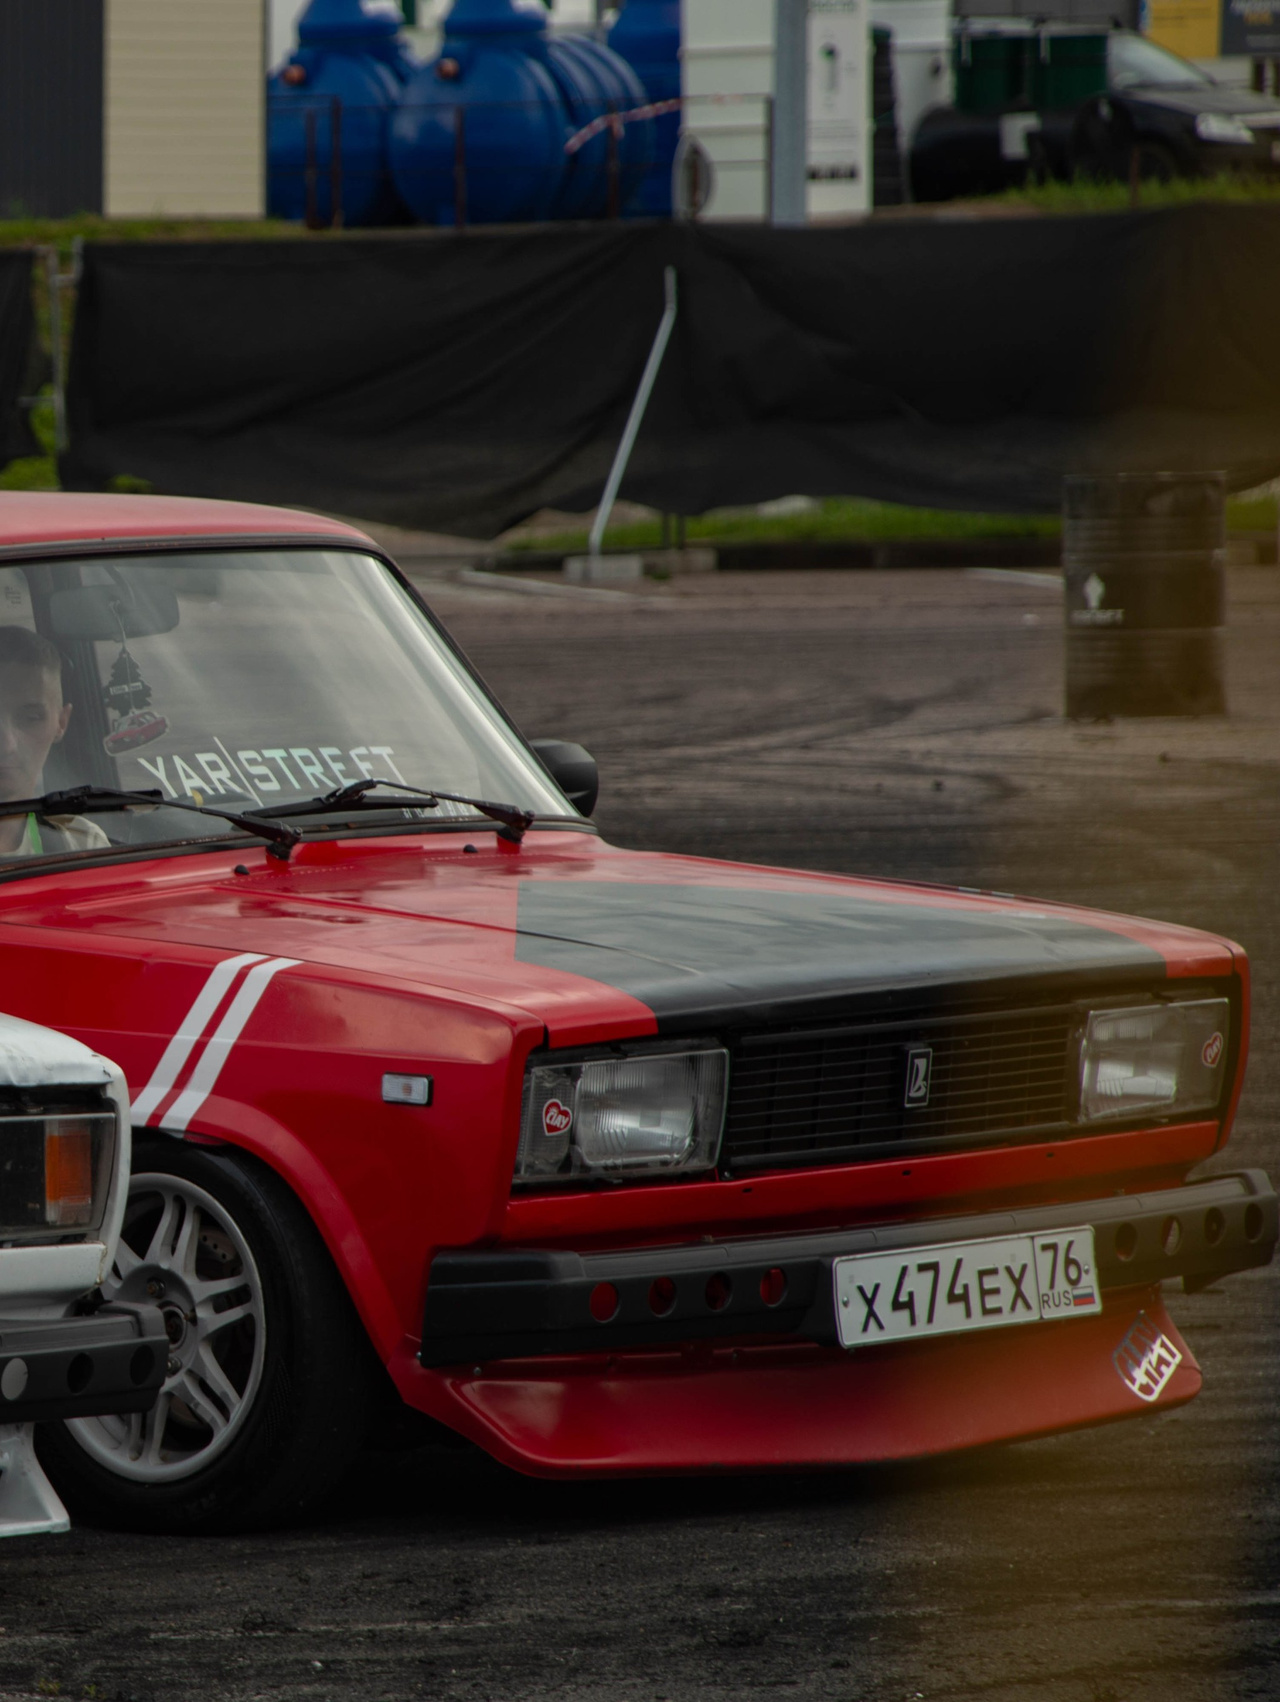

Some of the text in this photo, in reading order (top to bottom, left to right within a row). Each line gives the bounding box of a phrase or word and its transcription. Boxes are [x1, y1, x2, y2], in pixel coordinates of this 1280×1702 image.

[137, 745, 408, 799] YAR STREET
[1040, 1239, 1083, 1290] 76
[1041, 1289, 1073, 1311] RUS
